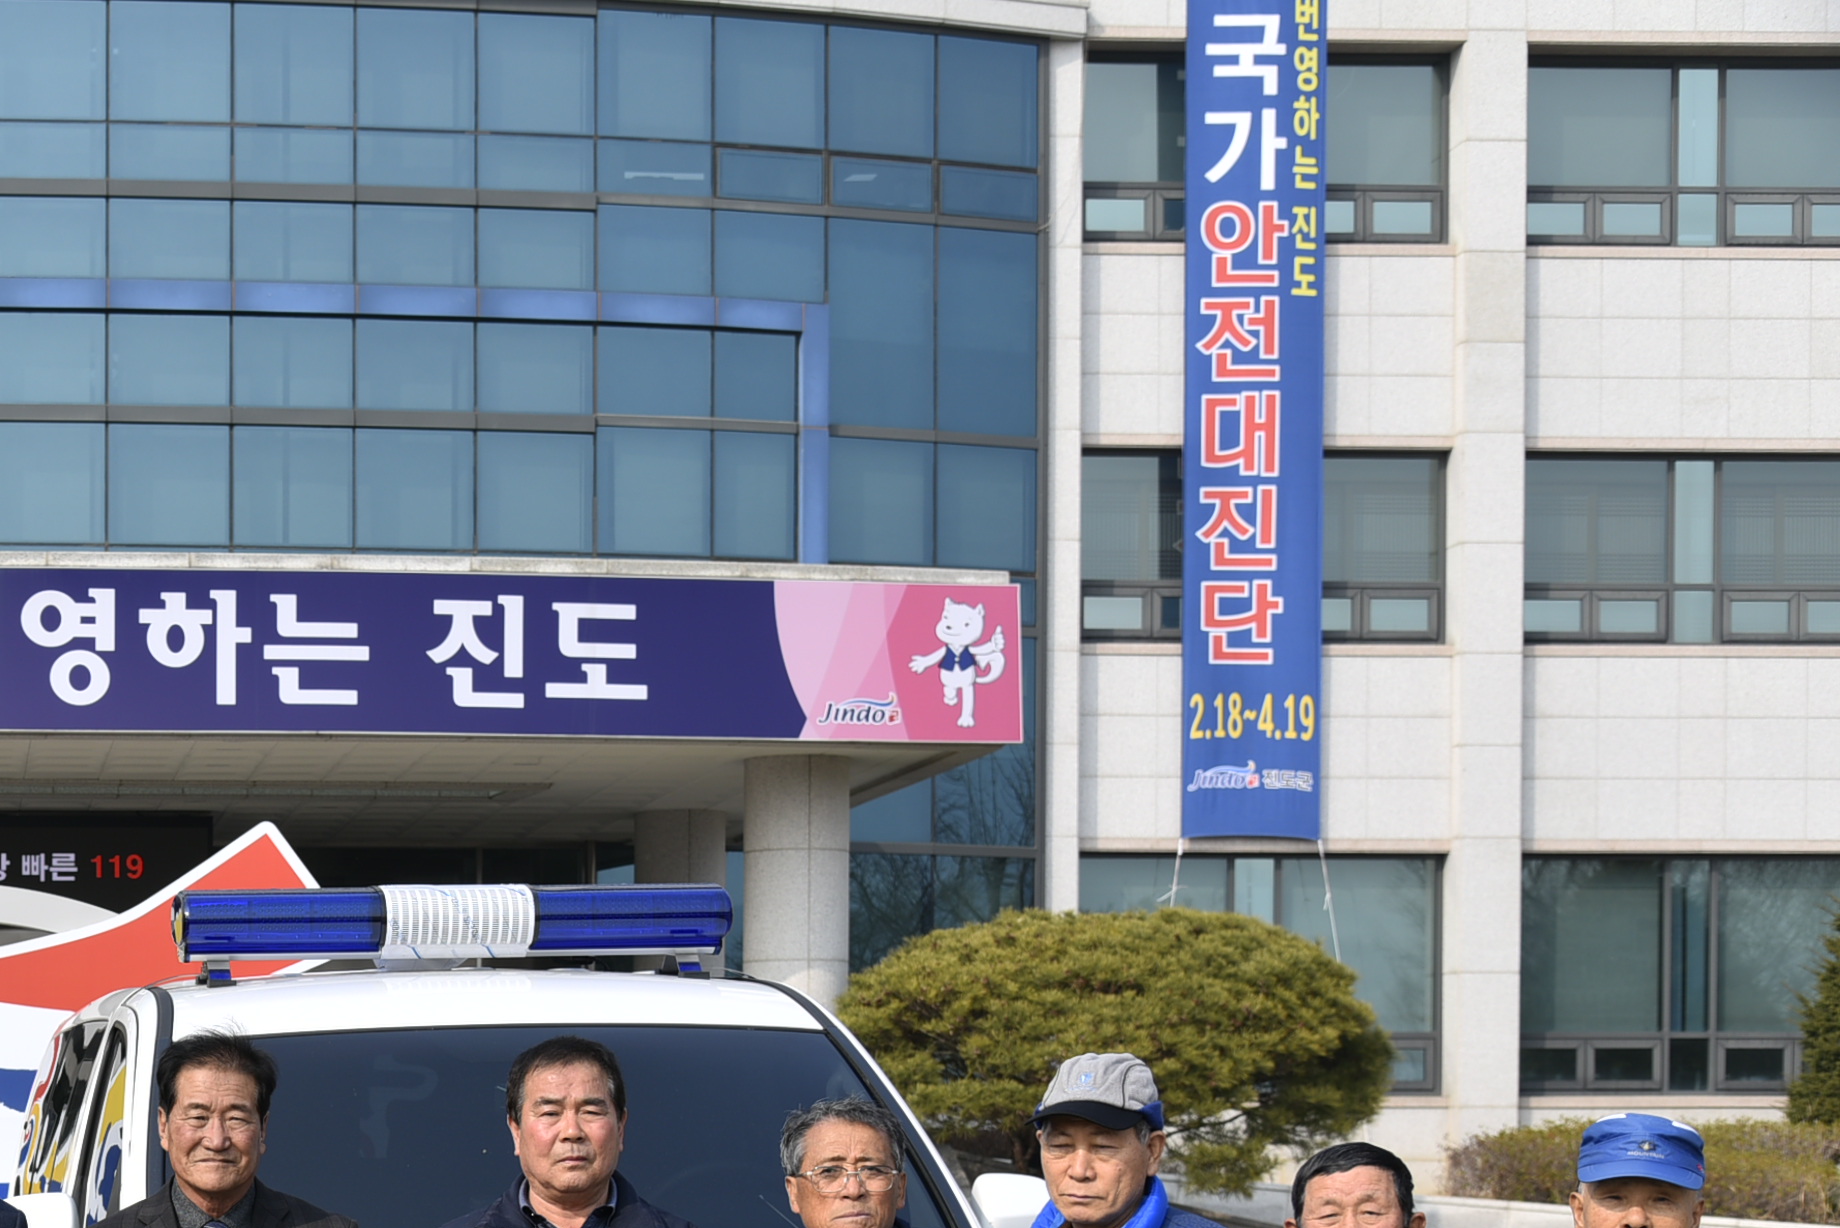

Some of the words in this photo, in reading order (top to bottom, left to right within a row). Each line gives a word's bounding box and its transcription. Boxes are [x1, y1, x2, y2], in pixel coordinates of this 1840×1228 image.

[1291, 206, 1318, 297] 진도
[426, 594, 648, 709] 진도
[817, 702, 886, 724] Jindo
[1189, 692, 1315, 741] 2.18~4.19
[1262, 769, 1313, 791] 진도군
[21, 852, 79, 882] 빠른
[91, 854, 144, 879] 119
